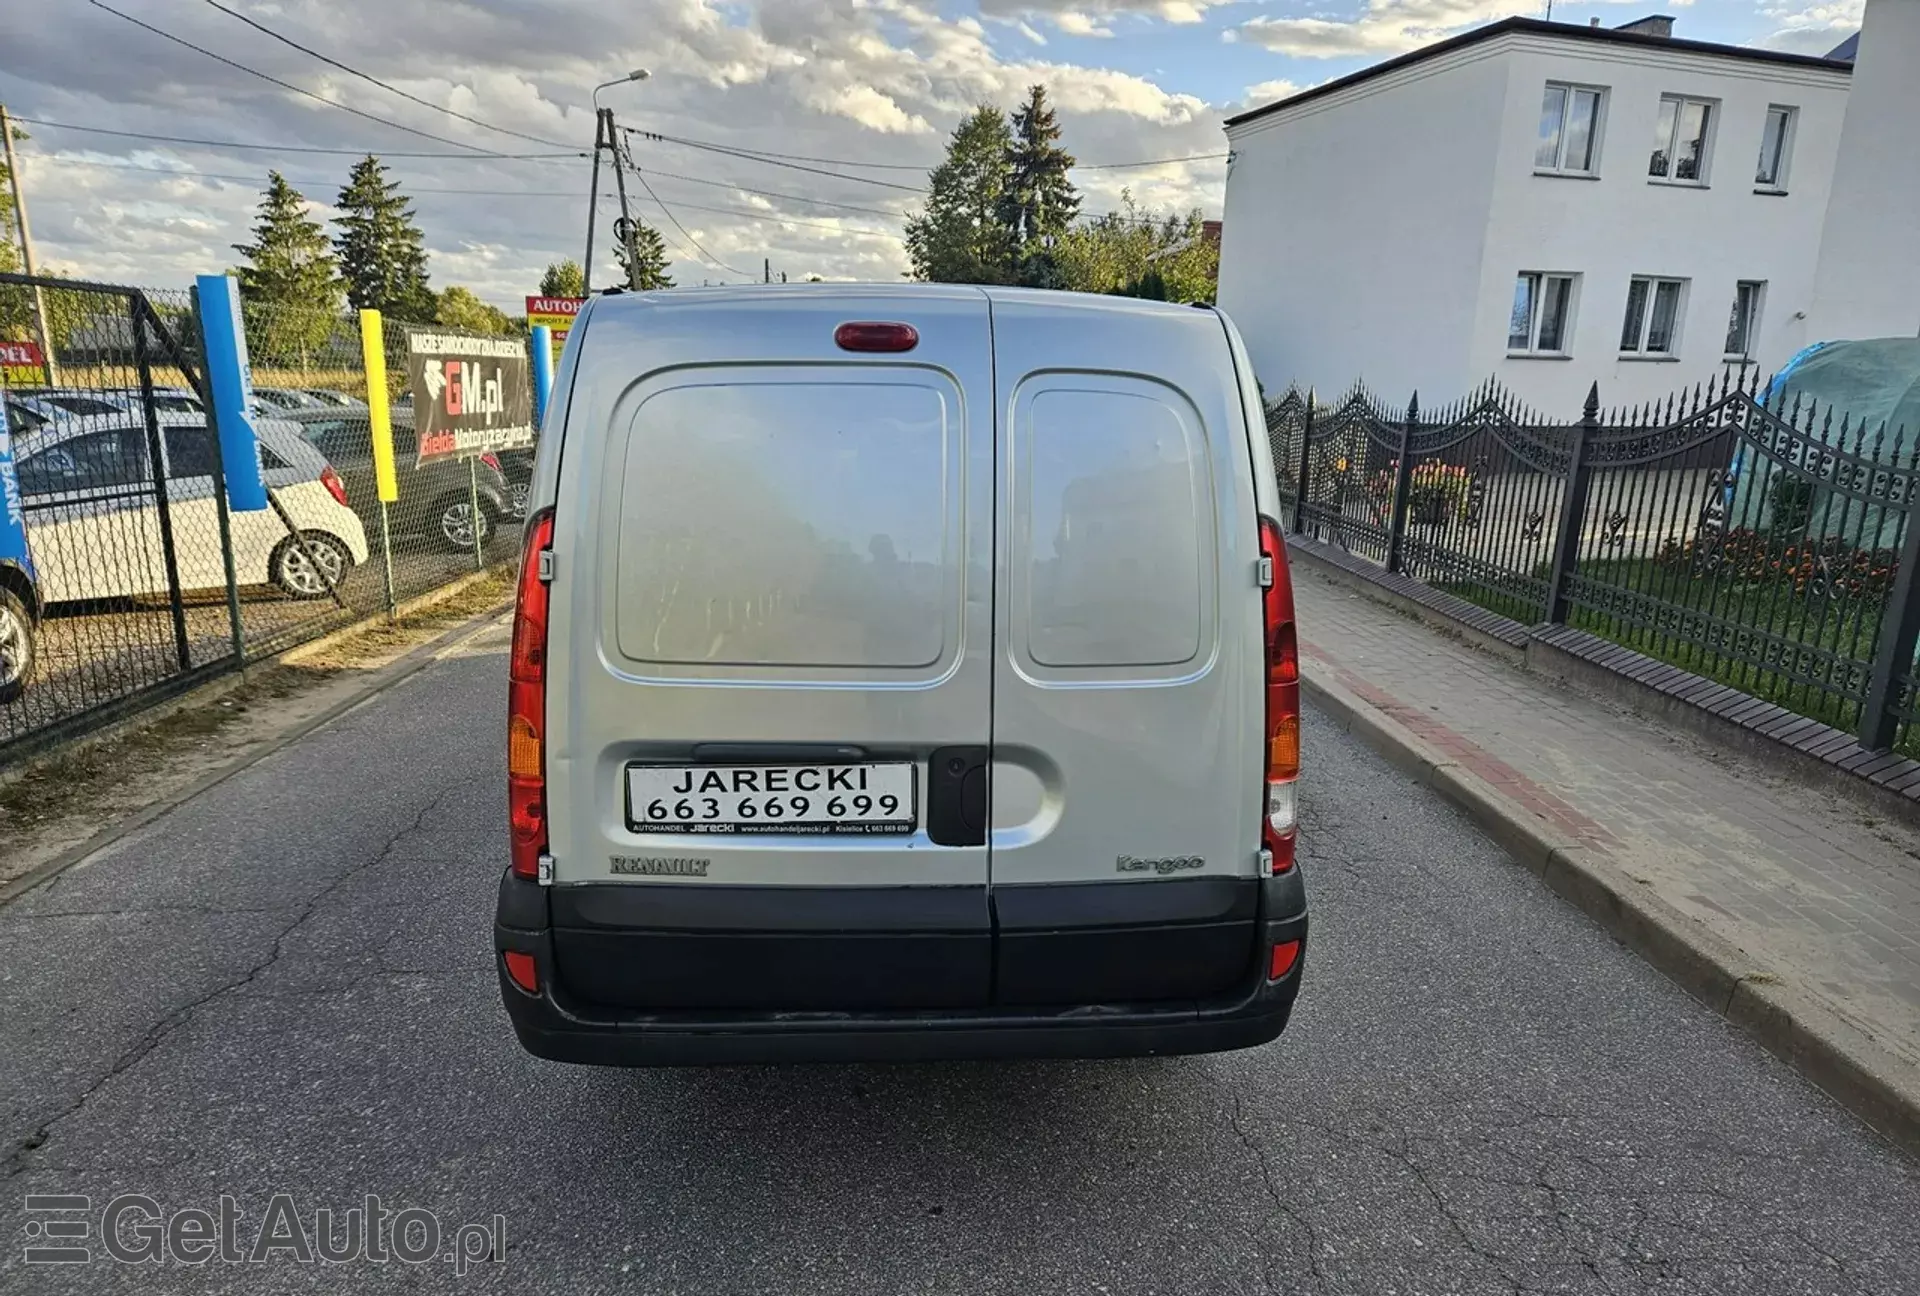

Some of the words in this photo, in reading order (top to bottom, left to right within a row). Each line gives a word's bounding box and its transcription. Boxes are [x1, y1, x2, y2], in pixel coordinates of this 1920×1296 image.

[445, 361, 503, 426] GM.pl
[1, 462, 22, 526] BANK
[673, 767, 867, 793] JARECKI
[647, 797, 720, 820] 663
[737, 796, 810, 819] 669
[826, 794, 900, 817] 699
[633, 823, 686, 832] AUTOHANDEL
[609, 855, 711, 877] RENAULT
[1116, 853, 1206, 875] Kangoo
